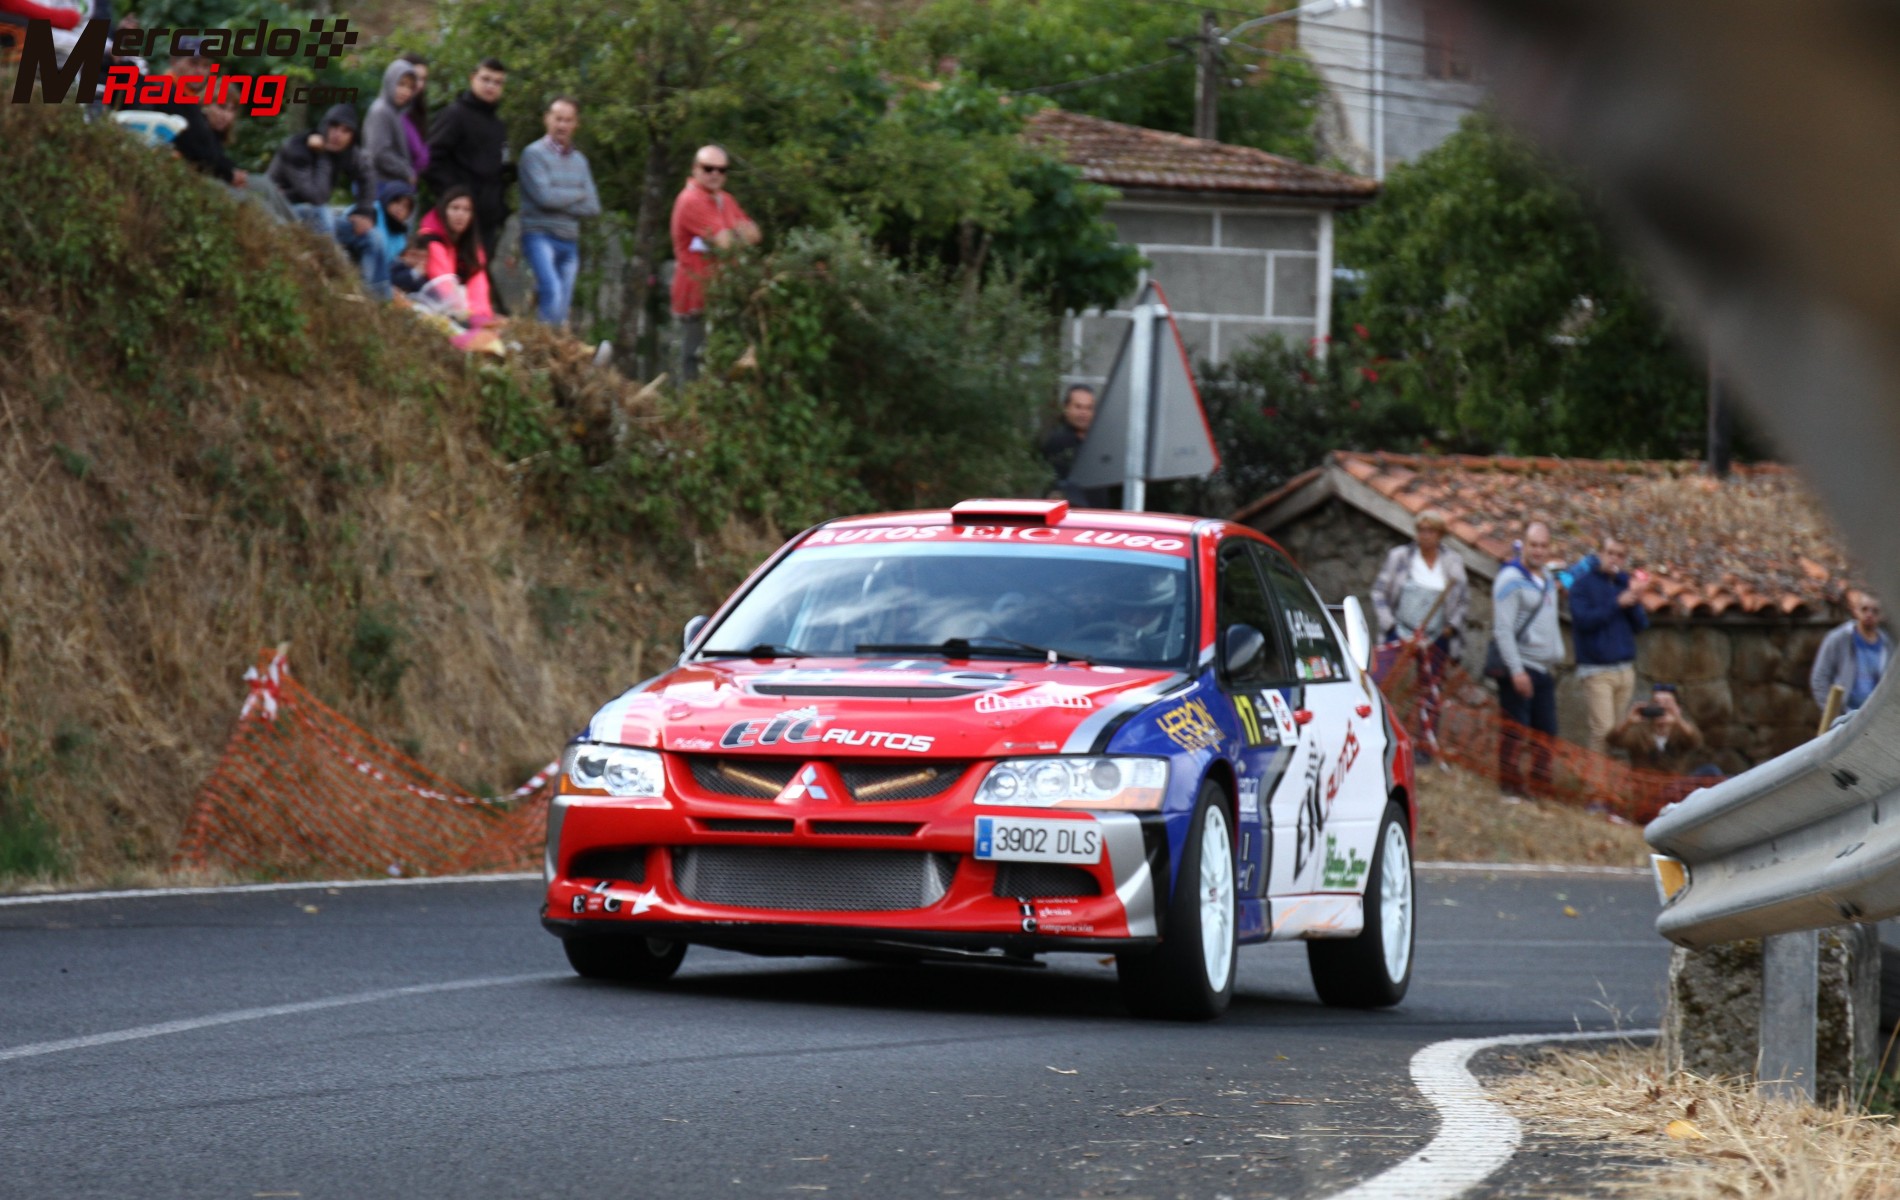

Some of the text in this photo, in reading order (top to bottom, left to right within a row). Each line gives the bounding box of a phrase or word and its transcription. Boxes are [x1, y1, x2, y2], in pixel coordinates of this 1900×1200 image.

[807, 526, 1184, 550] AUTOS EIC LUGO
[822, 727, 935, 752] AUTOS
[996, 827, 1097, 855] 3902 DLS
